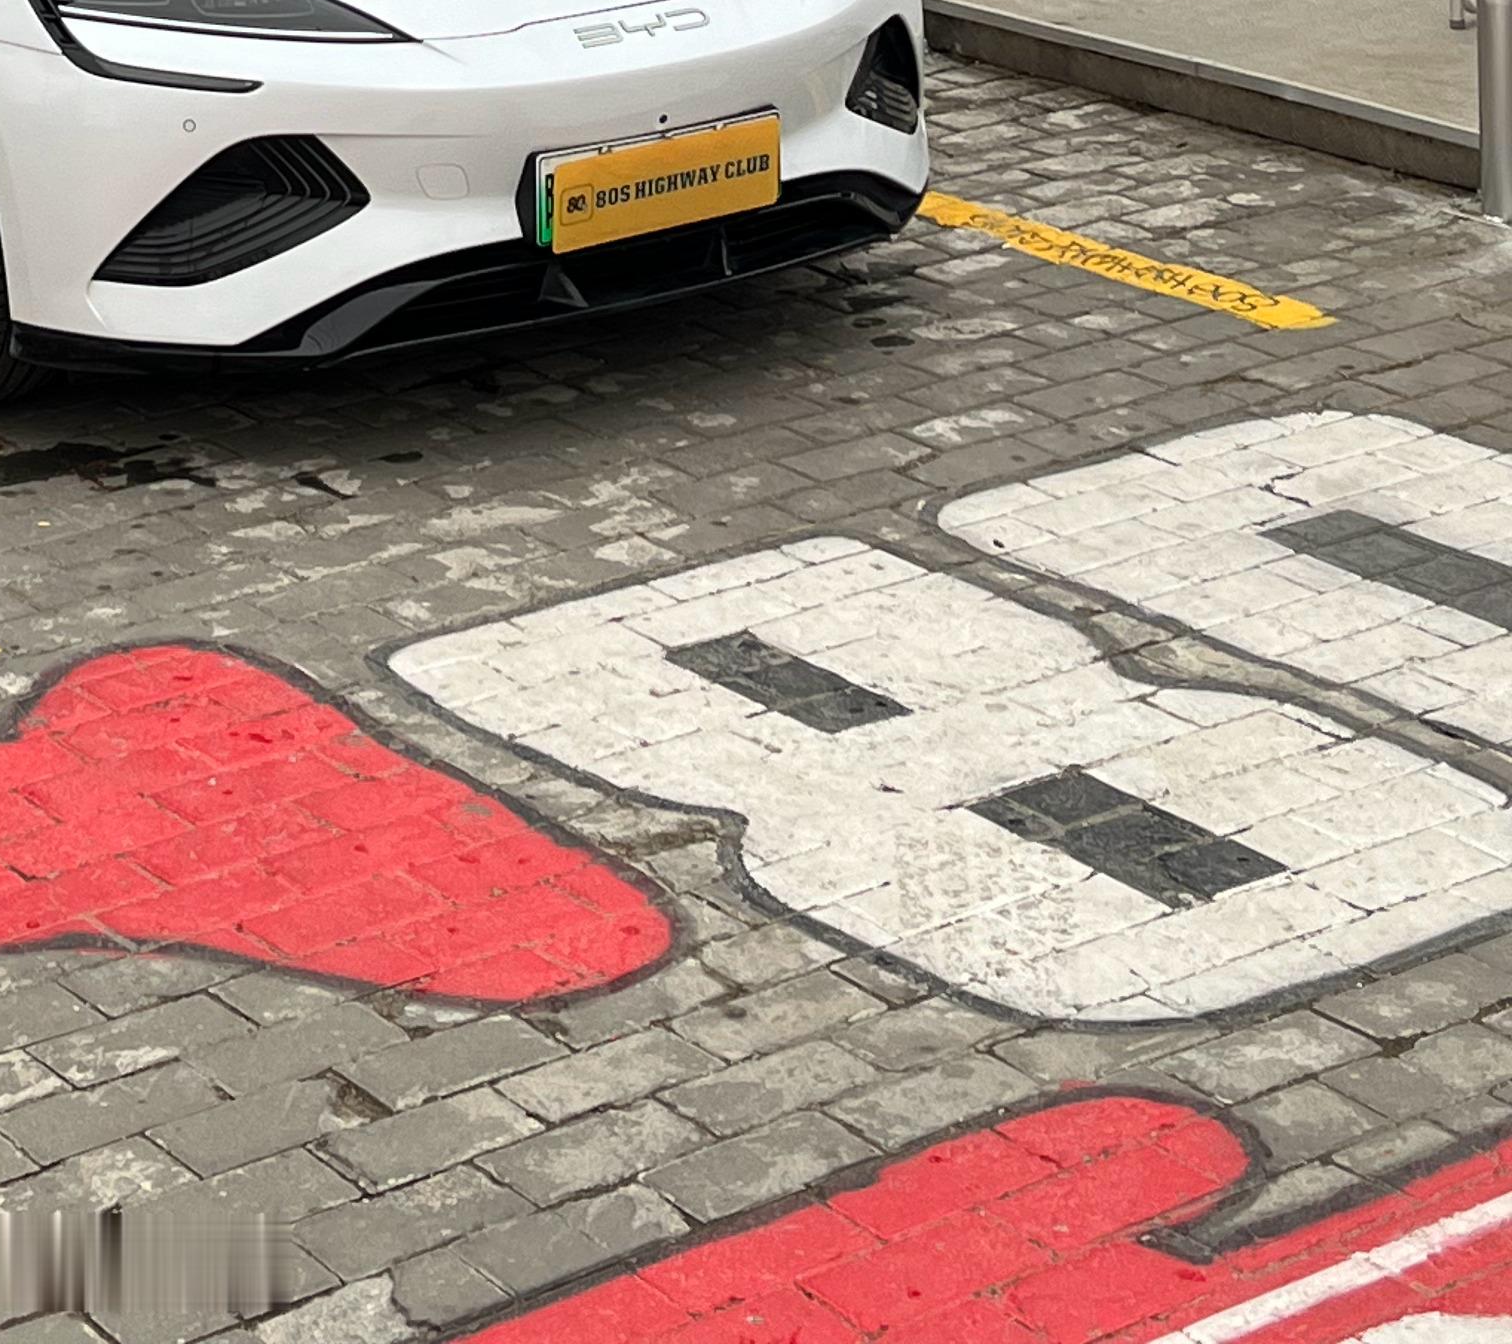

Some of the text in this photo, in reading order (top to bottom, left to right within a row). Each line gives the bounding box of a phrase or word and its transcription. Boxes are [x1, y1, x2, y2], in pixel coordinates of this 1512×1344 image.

[572, 6, 712, 50] BYD
[595, 185, 631, 209] 80S
[633, 163, 722, 201] HIGHWAY
[723, 153, 771, 180] CLUB
